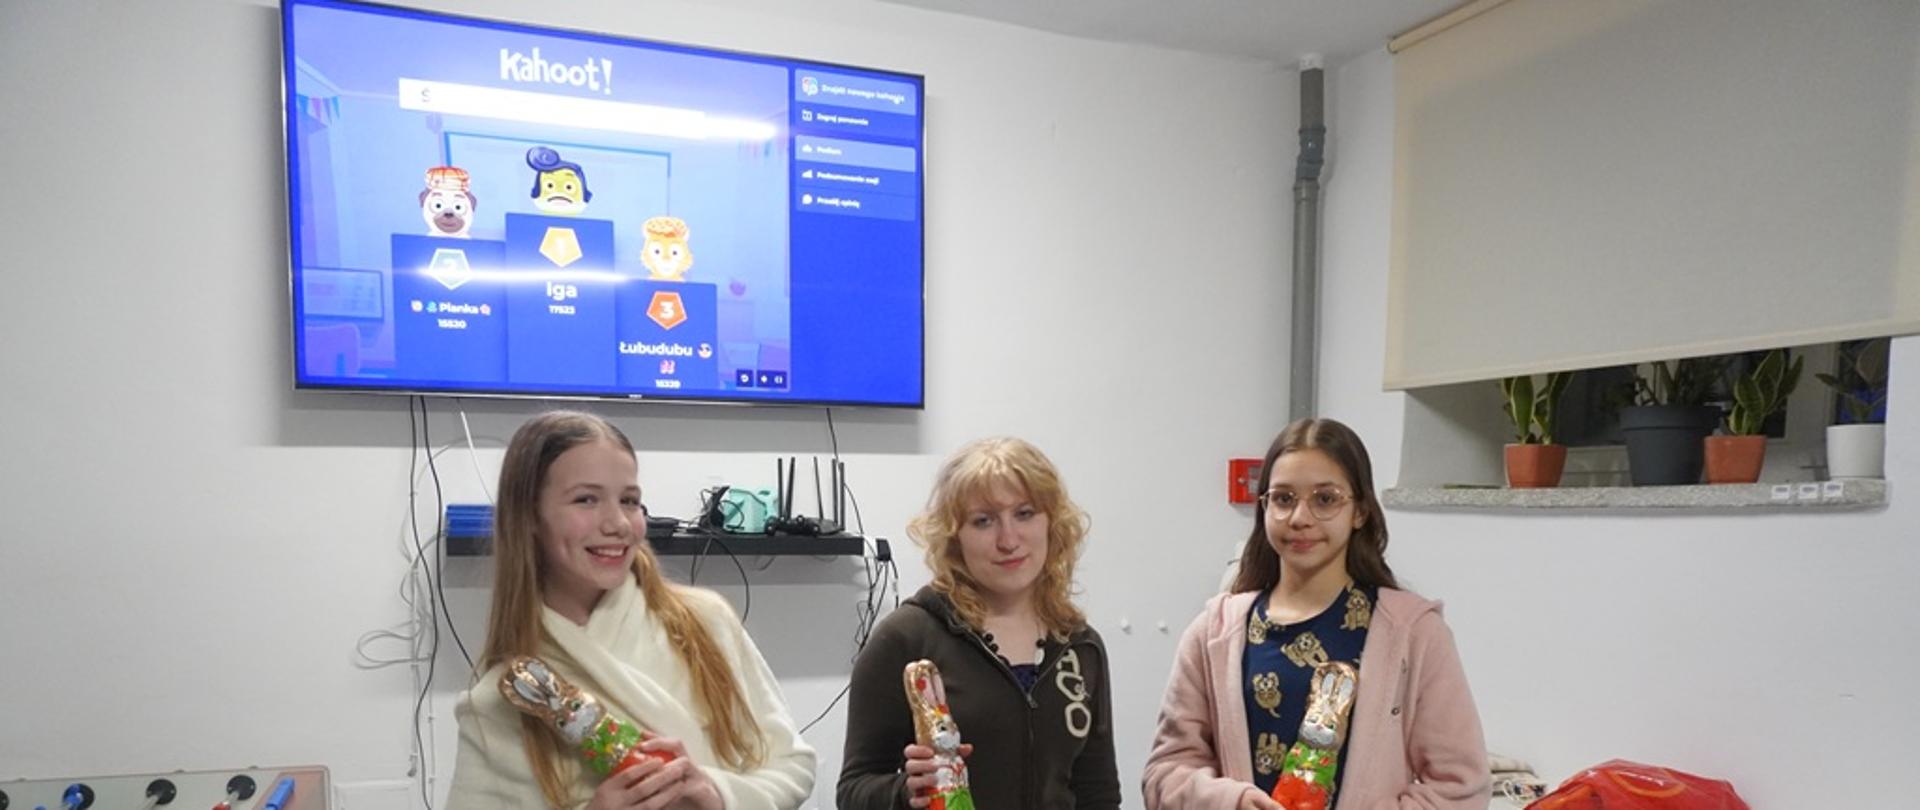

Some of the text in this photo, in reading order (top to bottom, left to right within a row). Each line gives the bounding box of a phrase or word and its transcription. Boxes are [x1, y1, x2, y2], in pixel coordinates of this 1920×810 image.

[500, 47, 612, 95] Kahoot!
[546, 281, 578, 301] Iga
[660, 302, 674, 319] 3
[619, 341, 693, 357] Łubudubu
